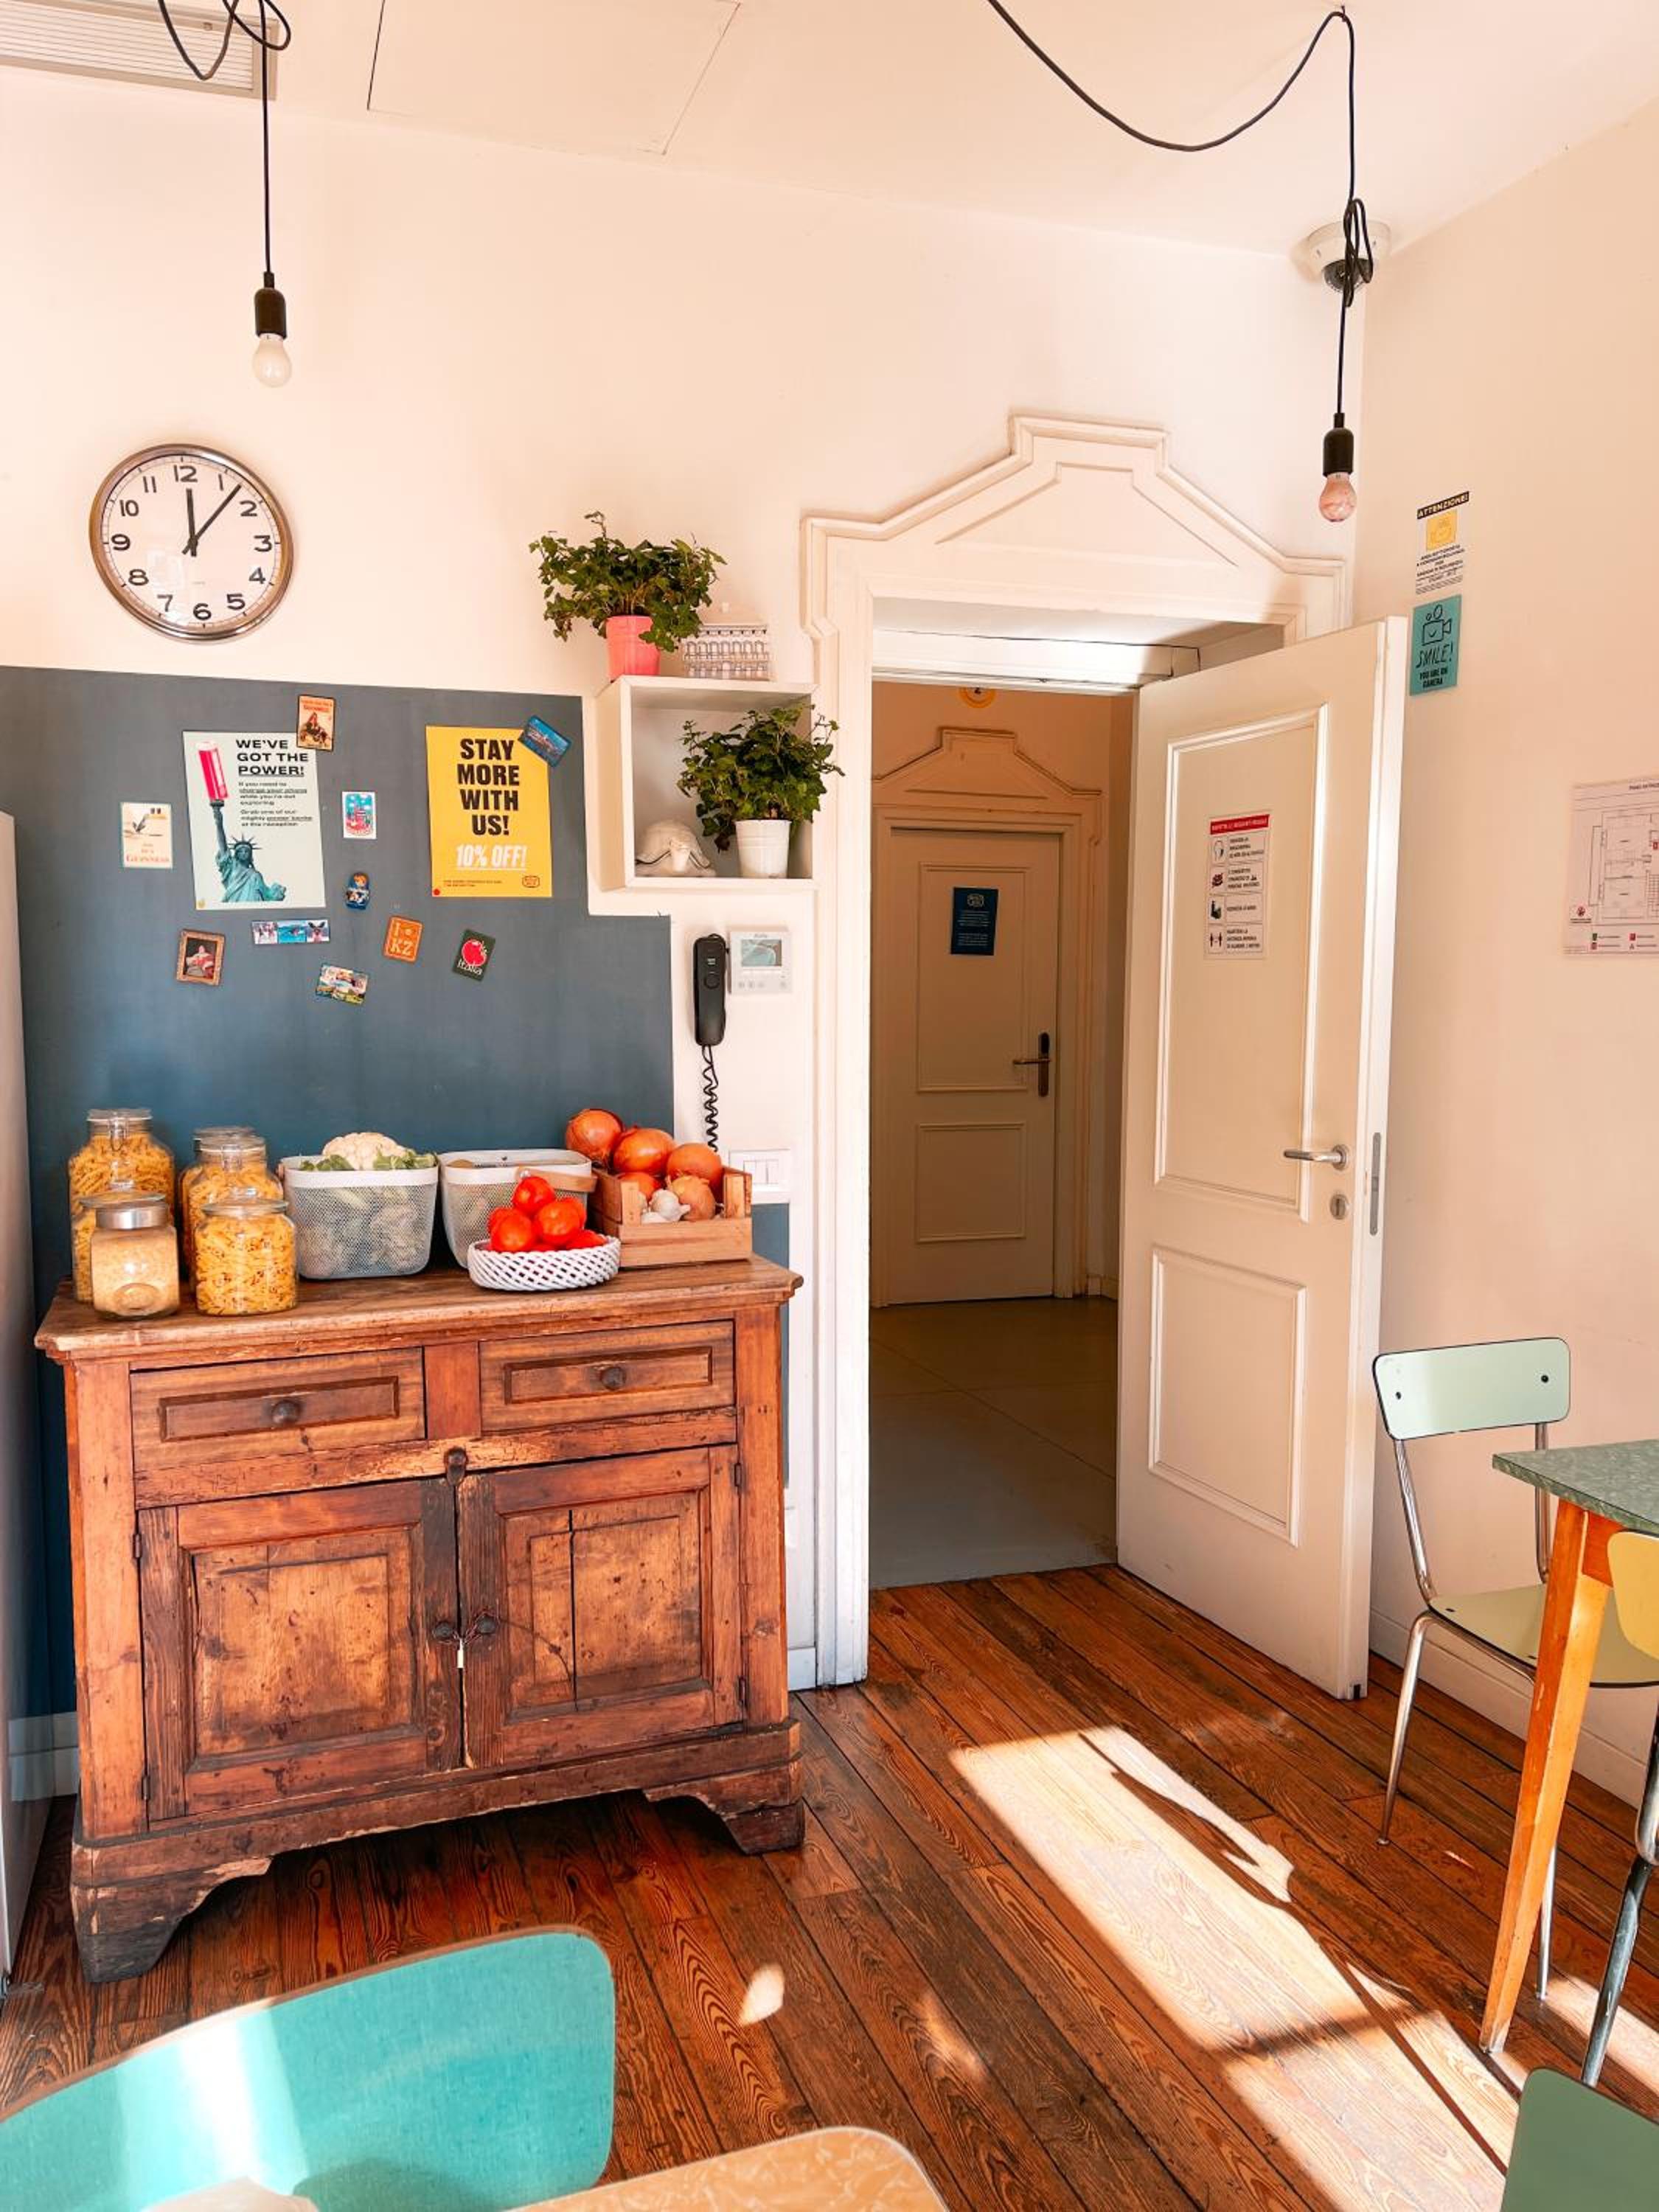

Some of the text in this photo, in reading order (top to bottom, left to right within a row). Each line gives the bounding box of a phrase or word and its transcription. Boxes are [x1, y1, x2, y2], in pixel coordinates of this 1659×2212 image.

[173, 465, 198, 482] 12
[218, 473, 224, 491] 1
[142, 476, 157, 493] 11
[119, 499, 139, 516] 10
[240, 501, 258, 516] 2
[1417, 493, 1469, 518] ATTENZIONE!
[111, 534, 131, 551] 9
[254, 535, 272, 552] 3
[128, 569, 149, 586] 8
[248, 568, 266, 584] 4
[157, 594, 173, 612] 7
[226, 594, 246, 611] 5
[193, 603, 212, 620] 6
[1416, 640, 1453, 668] SMILE!
[1419, 671, 1429, 681] YOU
[1422, 678, 1443, 688] CAMERA
[236, 740, 288, 749] WE'VE
[460, 739, 514, 760] STAY
[237, 753, 308, 762] GOT THE
[238, 766, 305, 775] POWER!
[457, 765, 520, 785] MORE
[459, 790, 519, 810] WITH
[472, 815, 509, 835] US!
[456, 845, 527, 869] 10% OFF!
